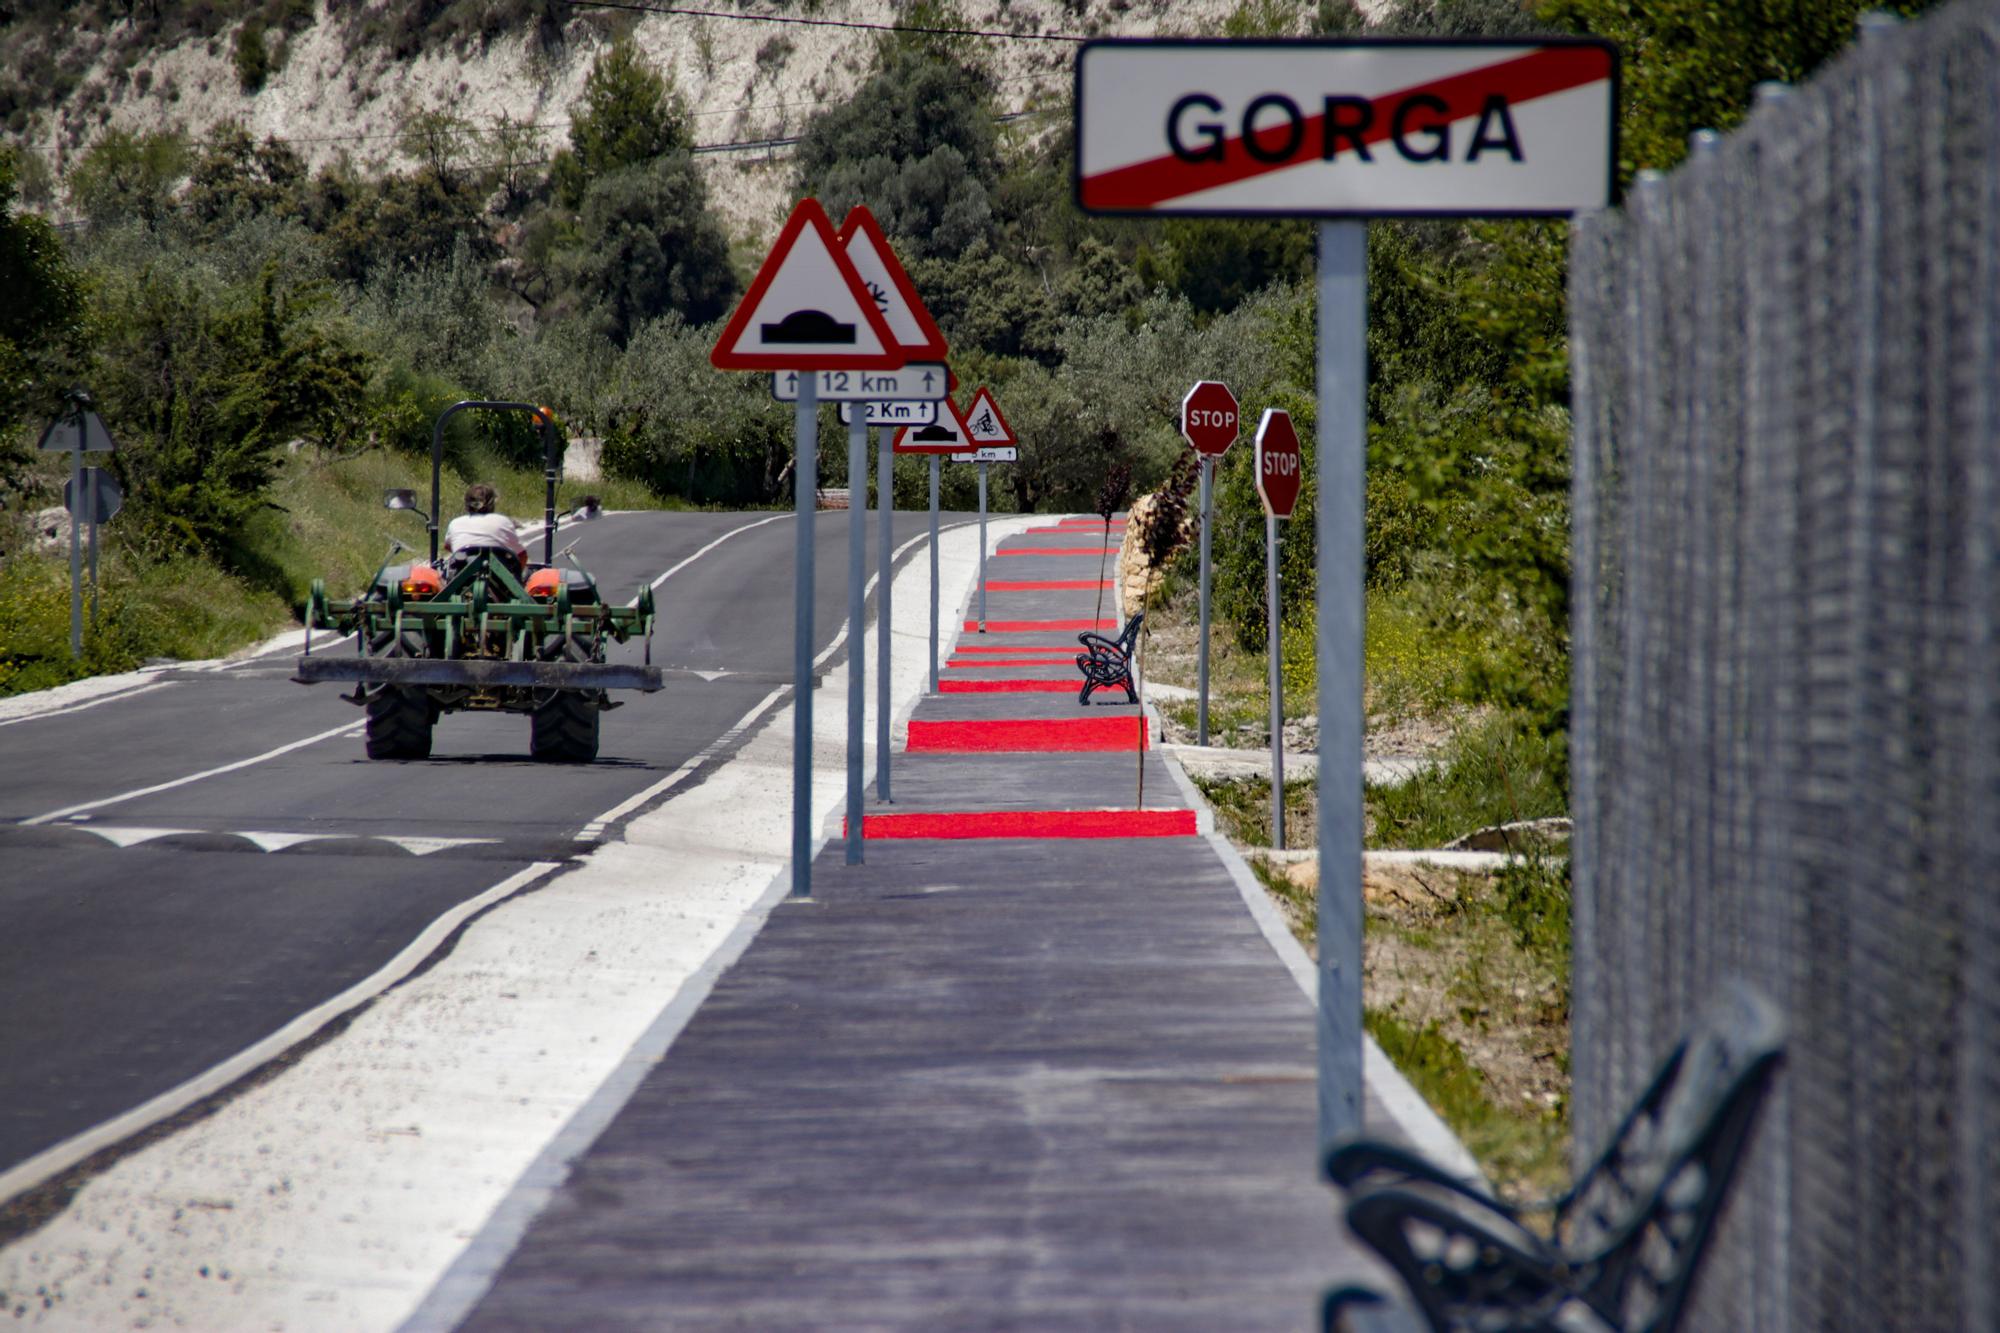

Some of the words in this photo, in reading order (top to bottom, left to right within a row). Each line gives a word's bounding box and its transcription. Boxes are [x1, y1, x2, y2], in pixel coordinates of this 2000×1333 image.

[1165, 92, 1526, 163] GORGA
[823, 372, 849, 392] 12
[861, 372, 898, 392] km
[881, 403, 910, 417] Km
[1190, 409, 1235, 428] STOP
[981, 450, 996, 458] km
[1264, 451, 1297, 476] STOP
